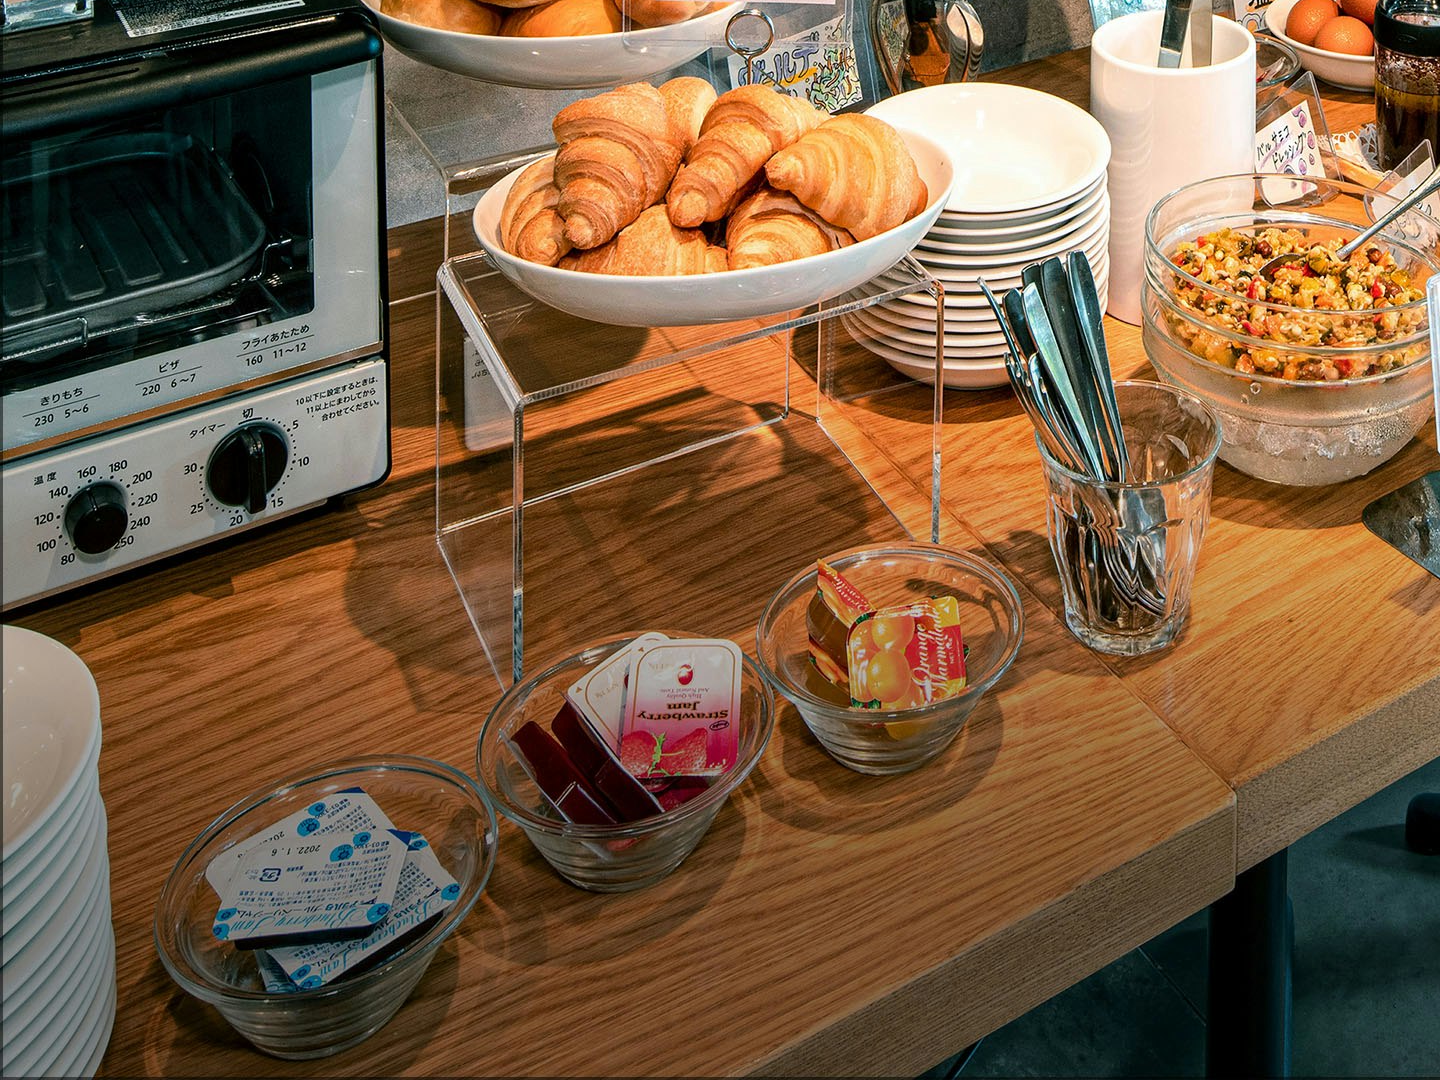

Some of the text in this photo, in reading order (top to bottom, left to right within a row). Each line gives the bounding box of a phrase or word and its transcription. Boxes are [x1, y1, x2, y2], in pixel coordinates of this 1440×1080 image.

[241, 325, 310, 351] フライあたため
[158, 358, 180, 373] ピザ
[245, 354, 264, 368] 160
[40, 386, 83, 407] きりもち
[142, 383, 161, 397] 220
[242, 407, 254, 419] 切
[34, 413, 54, 428] 230
[292, 419, 299, 430] 5
[189, 422, 226, 439] タイマー
[108, 459, 128, 473] 180
[183, 462, 198, 475] 30
[297, 456, 310, 467] 10
[33, 472, 57, 486] 温度
[77, 465, 97, 479] 160
[132, 470, 153, 485] 200
[49, 485, 69, 499] 140
[137, 492, 158, 507] 220
[271, 496, 284, 509] 15
[190, 502, 204, 515] 25
[34, 512, 54, 526] 120
[130, 515, 151, 530] 240
[229, 515, 243, 527] 20
[36, 538, 57, 553] 100
[113, 535, 135, 550] 250
[60, 552, 76, 566] 80
[924, 607, 948, 688] Marmalade
[911, 623, 930, 687] Orange
[666, 701, 701, 711] Jam
[637, 708, 730, 722] Strawberry
